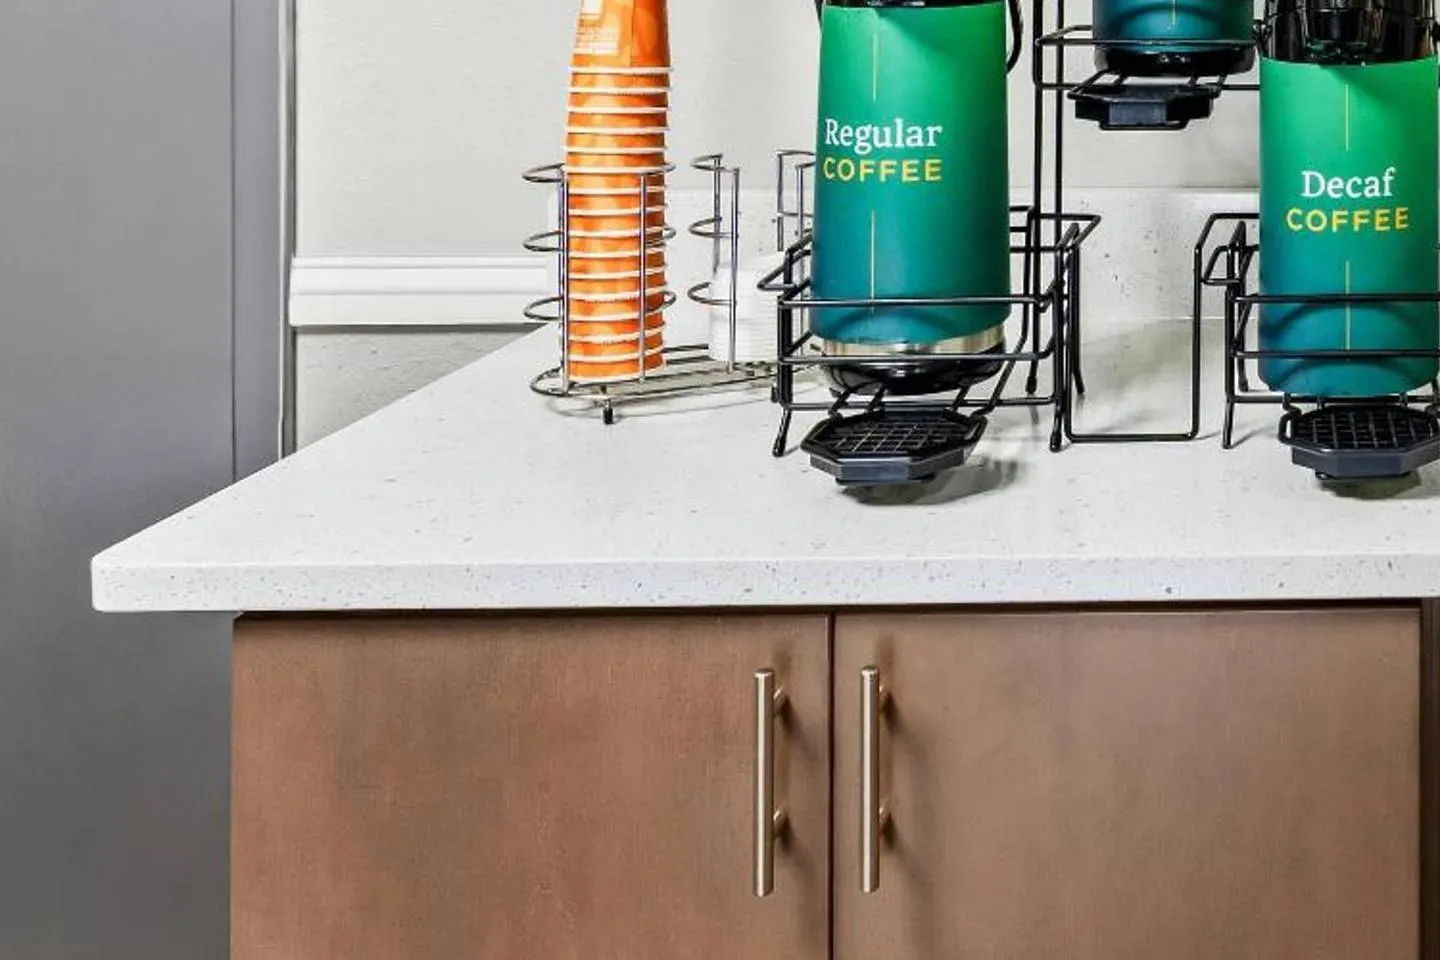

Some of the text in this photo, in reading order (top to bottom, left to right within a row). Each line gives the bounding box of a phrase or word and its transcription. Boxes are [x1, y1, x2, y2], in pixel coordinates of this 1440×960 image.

[825, 117, 943, 155] Regular
[823, 157, 942, 182] COFFEE
[1301, 166, 1396, 199] Decaf
[1286, 206, 1408, 233] COFFEE
